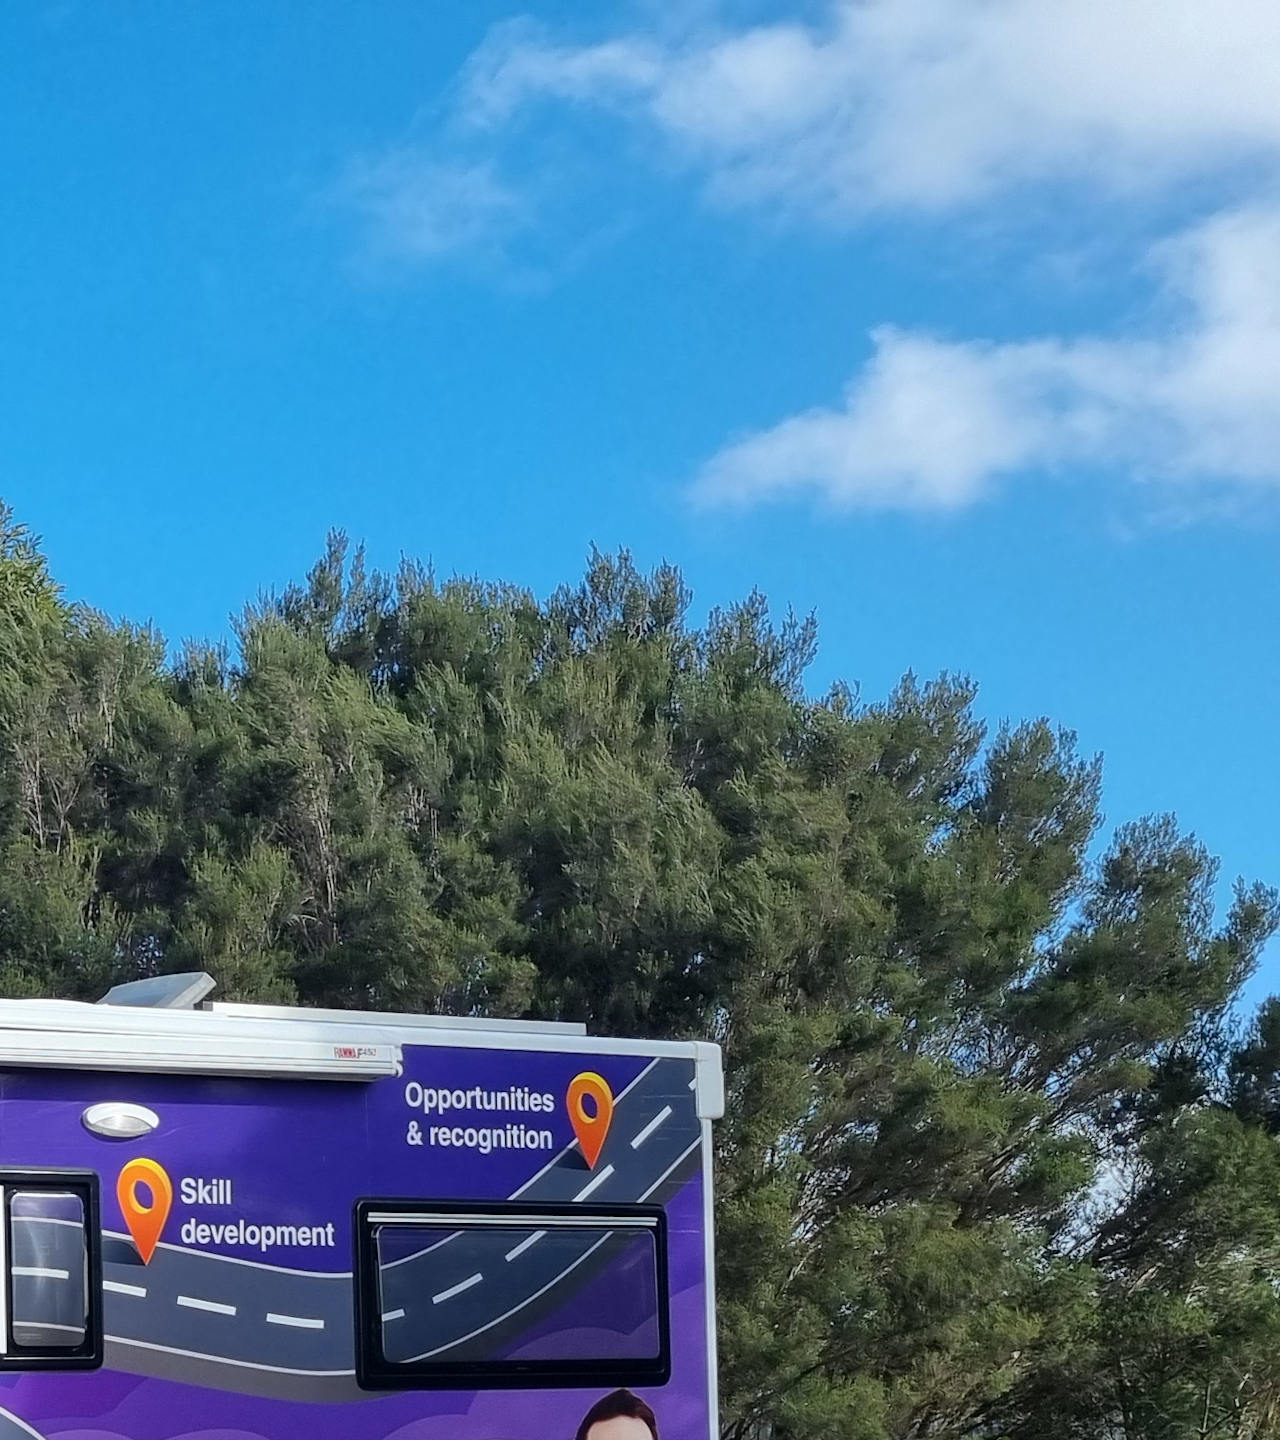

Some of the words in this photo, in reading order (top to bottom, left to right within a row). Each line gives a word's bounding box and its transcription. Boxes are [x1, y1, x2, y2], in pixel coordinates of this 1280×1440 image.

[405, 1081, 555, 1114] Opportunities
[406, 1120, 424, 1146] &
[429, 1123, 553, 1154] recognition
[180, 1178, 232, 1205] Skill
[180, 1219, 335, 1252] development
